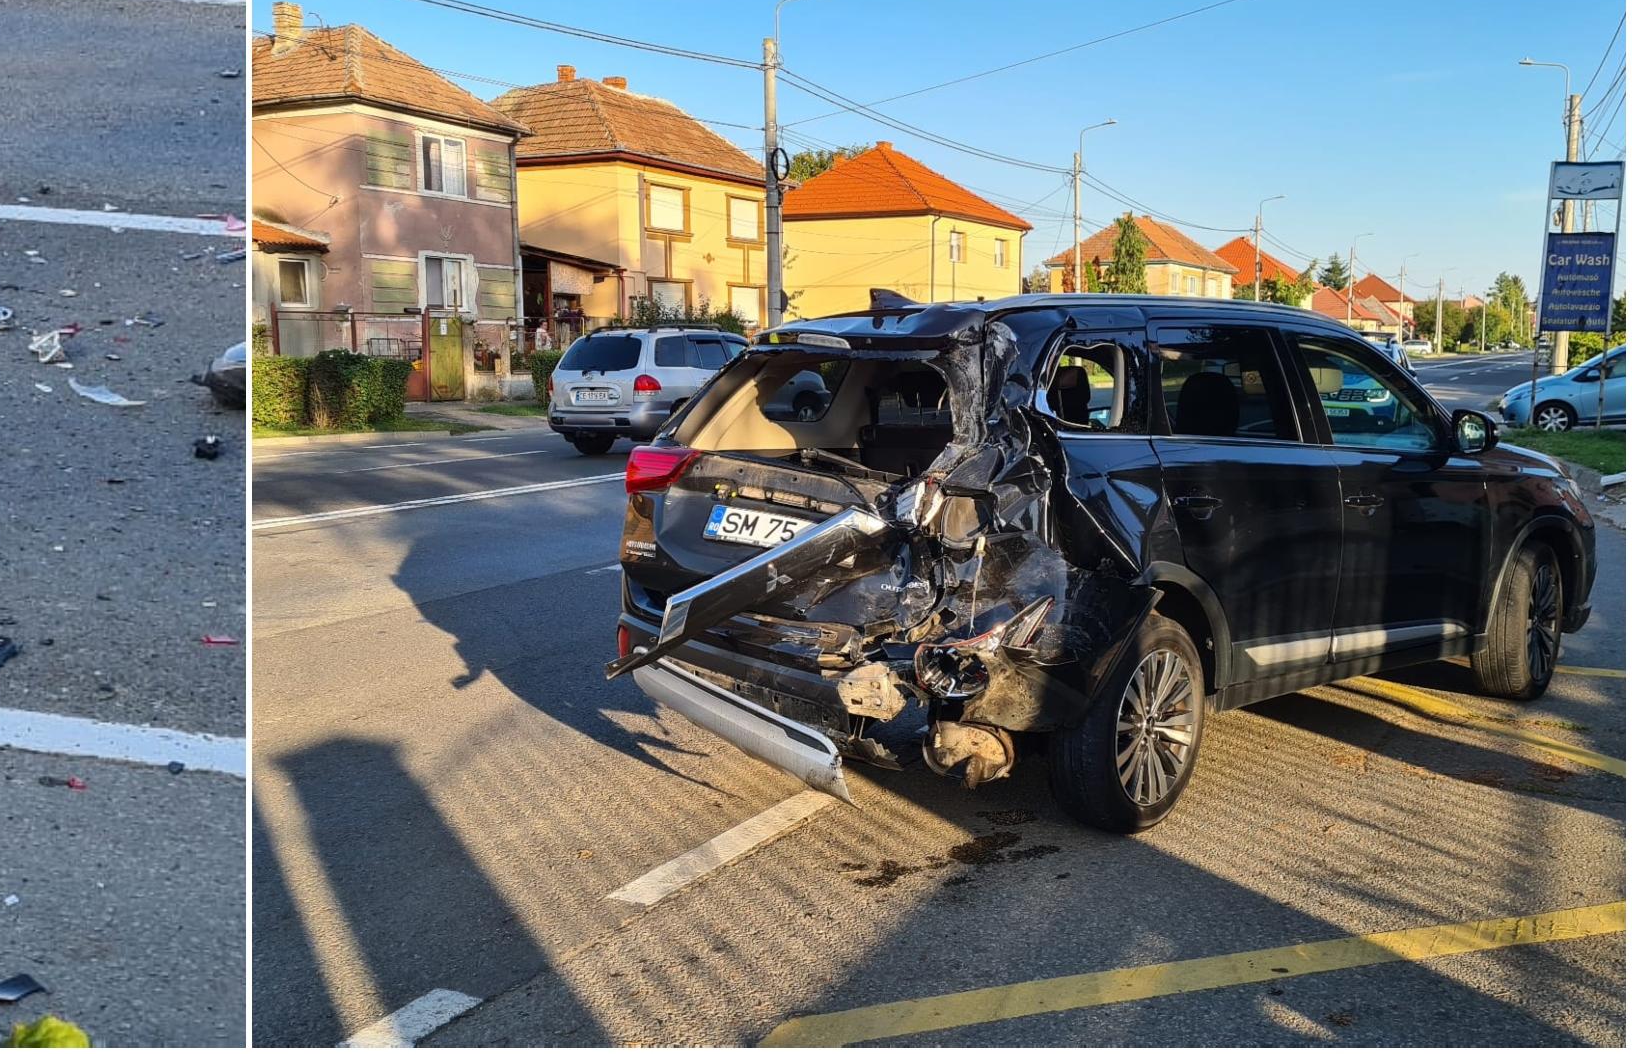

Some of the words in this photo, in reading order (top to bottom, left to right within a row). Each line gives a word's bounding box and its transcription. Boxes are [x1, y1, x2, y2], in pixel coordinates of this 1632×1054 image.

[1548, 254, 1571, 266] Car
[1575, 253, 1610, 266] Wash
[708, 521, 719, 532] RO
[722, 512, 760, 537] SM
[764, 518, 798, 543] 75
